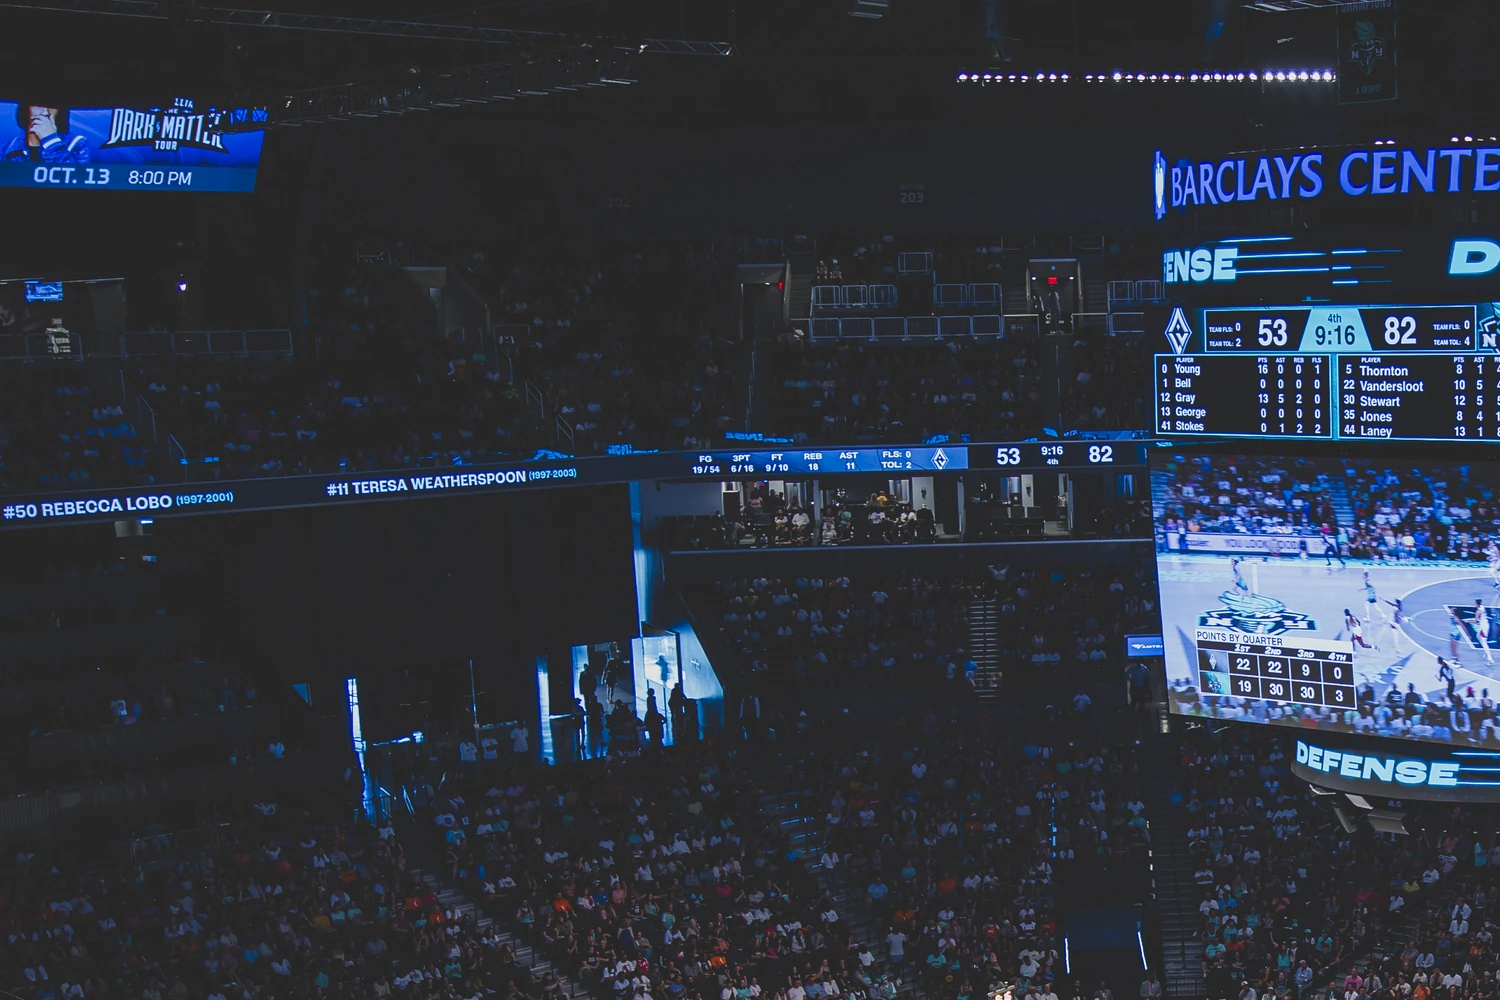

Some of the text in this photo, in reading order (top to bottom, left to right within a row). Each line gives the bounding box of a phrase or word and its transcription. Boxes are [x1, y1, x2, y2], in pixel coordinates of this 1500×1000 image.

[107, 108, 155, 145] DARK
[155, 140, 177, 150] TOUR
[33, 166, 192, 186] OCT. 13 8:00 PM
[1171, 153, 1323, 206] BARCLAYS
[1258, 319, 1287, 346] 53
[1328, 313, 1341, 323] 4th
[1384, 316, 1416, 344] 82
[1315, 325, 1356, 345] 9:16
[1162, 364, 1201, 376] 0 Young
[1345, 364, 1408, 376] 5 Thornton
[1163, 378, 1191, 388] 1 Bell
[1343, 380, 1423, 391] 22 Vandersloot
[1160, 393, 1195, 404] 12 Gray
[1343, 395, 1400, 407] 30 Stewart
[1161, 407, 1206, 418] 13 George
[1343, 410, 1392, 422] 35 Jones
[1161, 421, 1204, 431] 41 Stokes
[1344, 425, 1392, 438] 44 Laney
[698, 450, 911, 464] FG 3PT FT REB AST FLS: 0
[996, 445, 1113, 465] 53 9:16 82
[1046, 457, 1059, 466] 4th
[808, 462, 819, 471] 18
[846, 462, 855, 470] 11
[881, 461, 902, 469] TOL:
[905, 461, 912, 469] 2
[327, 468, 577, 496] #11 TERESA WEATHERSPOON (1997-2003)
[3, 492, 234, 519] #50 REBECCA LOBO (1997-2001)
[1197, 631, 1283, 646] POINTS BY QUARTER
[1328, 652, 1347, 661] 4TH
[1236, 658, 1342, 679] 22 22 9 0
[1238, 680, 1343, 701] 19 30 30 3
[1296, 740, 1460, 787] DEFENSE
